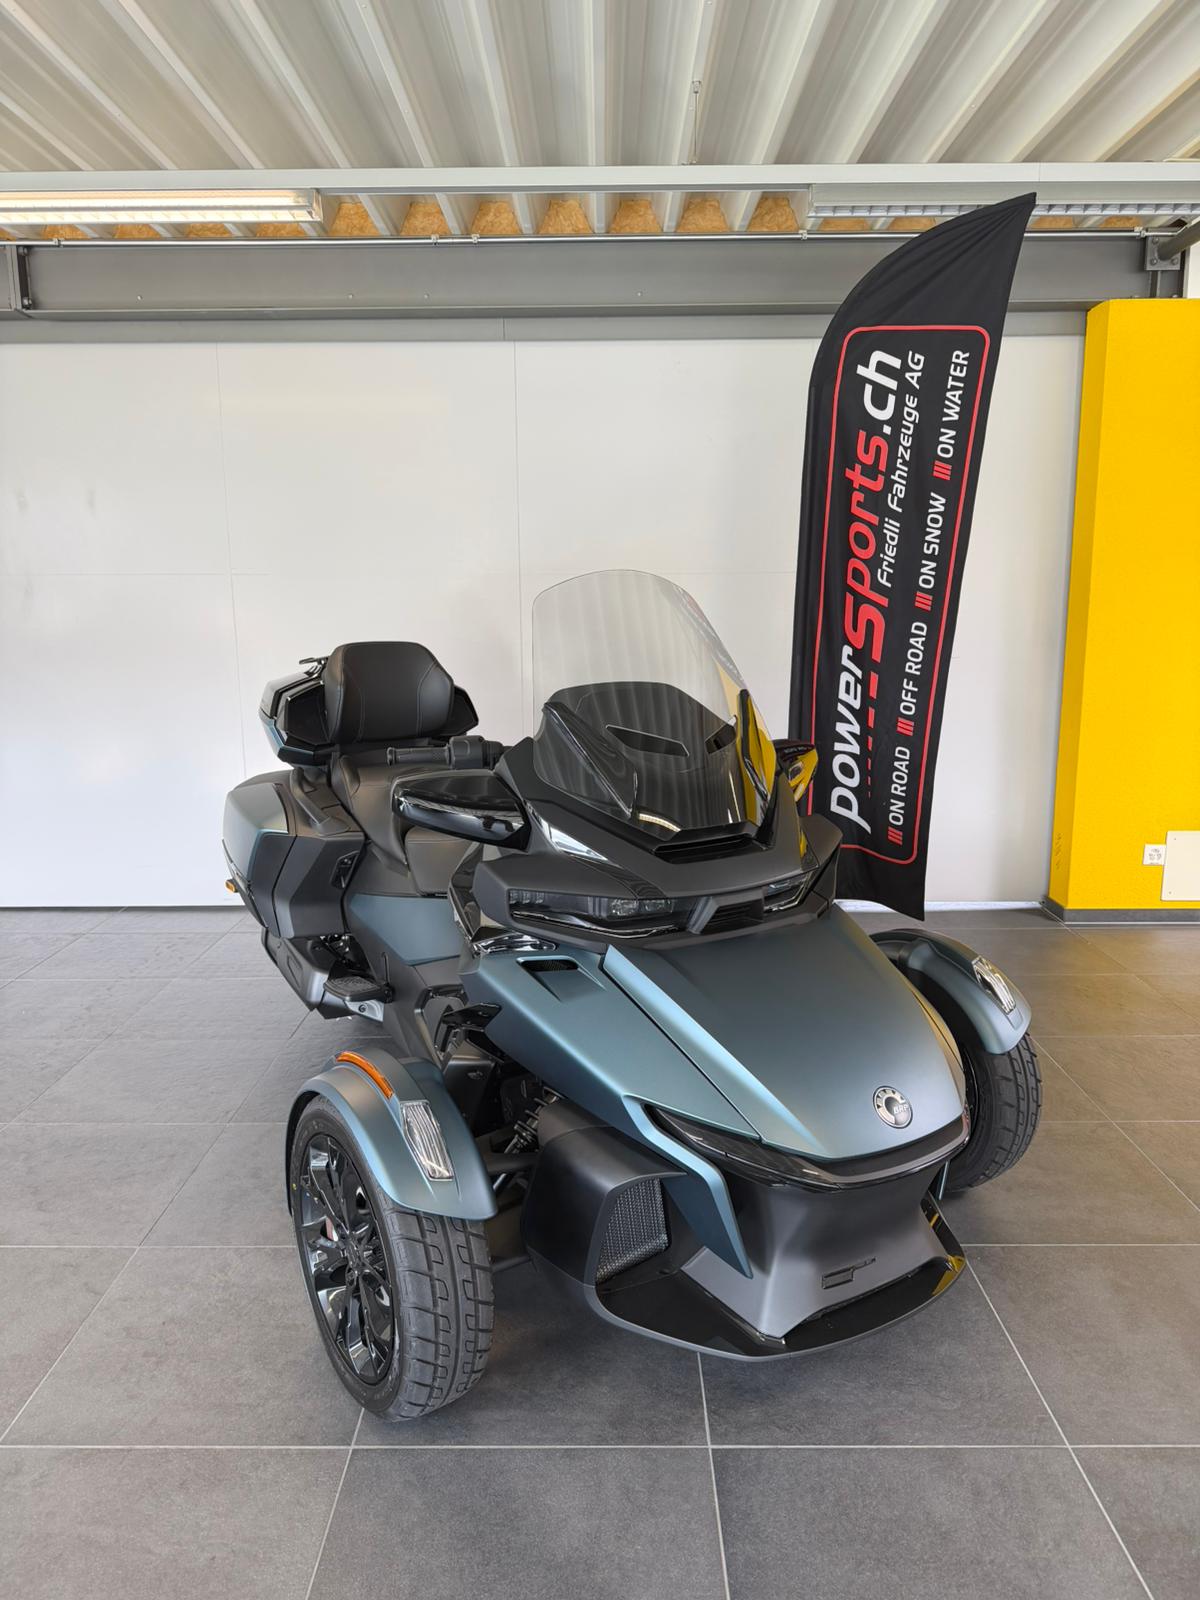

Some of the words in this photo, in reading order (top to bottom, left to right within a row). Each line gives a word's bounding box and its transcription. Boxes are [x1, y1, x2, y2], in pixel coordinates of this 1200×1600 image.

[904, 350, 925, 389] AG
[942, 350, 970, 423] WATER
[887, 393, 919, 512] Fahrzeuge
[936, 428, 956, 459] ON
[923, 492, 947, 556] SNOW
[877, 517, 901, 588] Friedli
[918, 559, 937, 589] ON
[905, 621, 927, 676] ROAD
[900, 678, 918, 716] OFF
[890, 746, 910, 797] ROAD
[889, 799, 906, 826] ON
